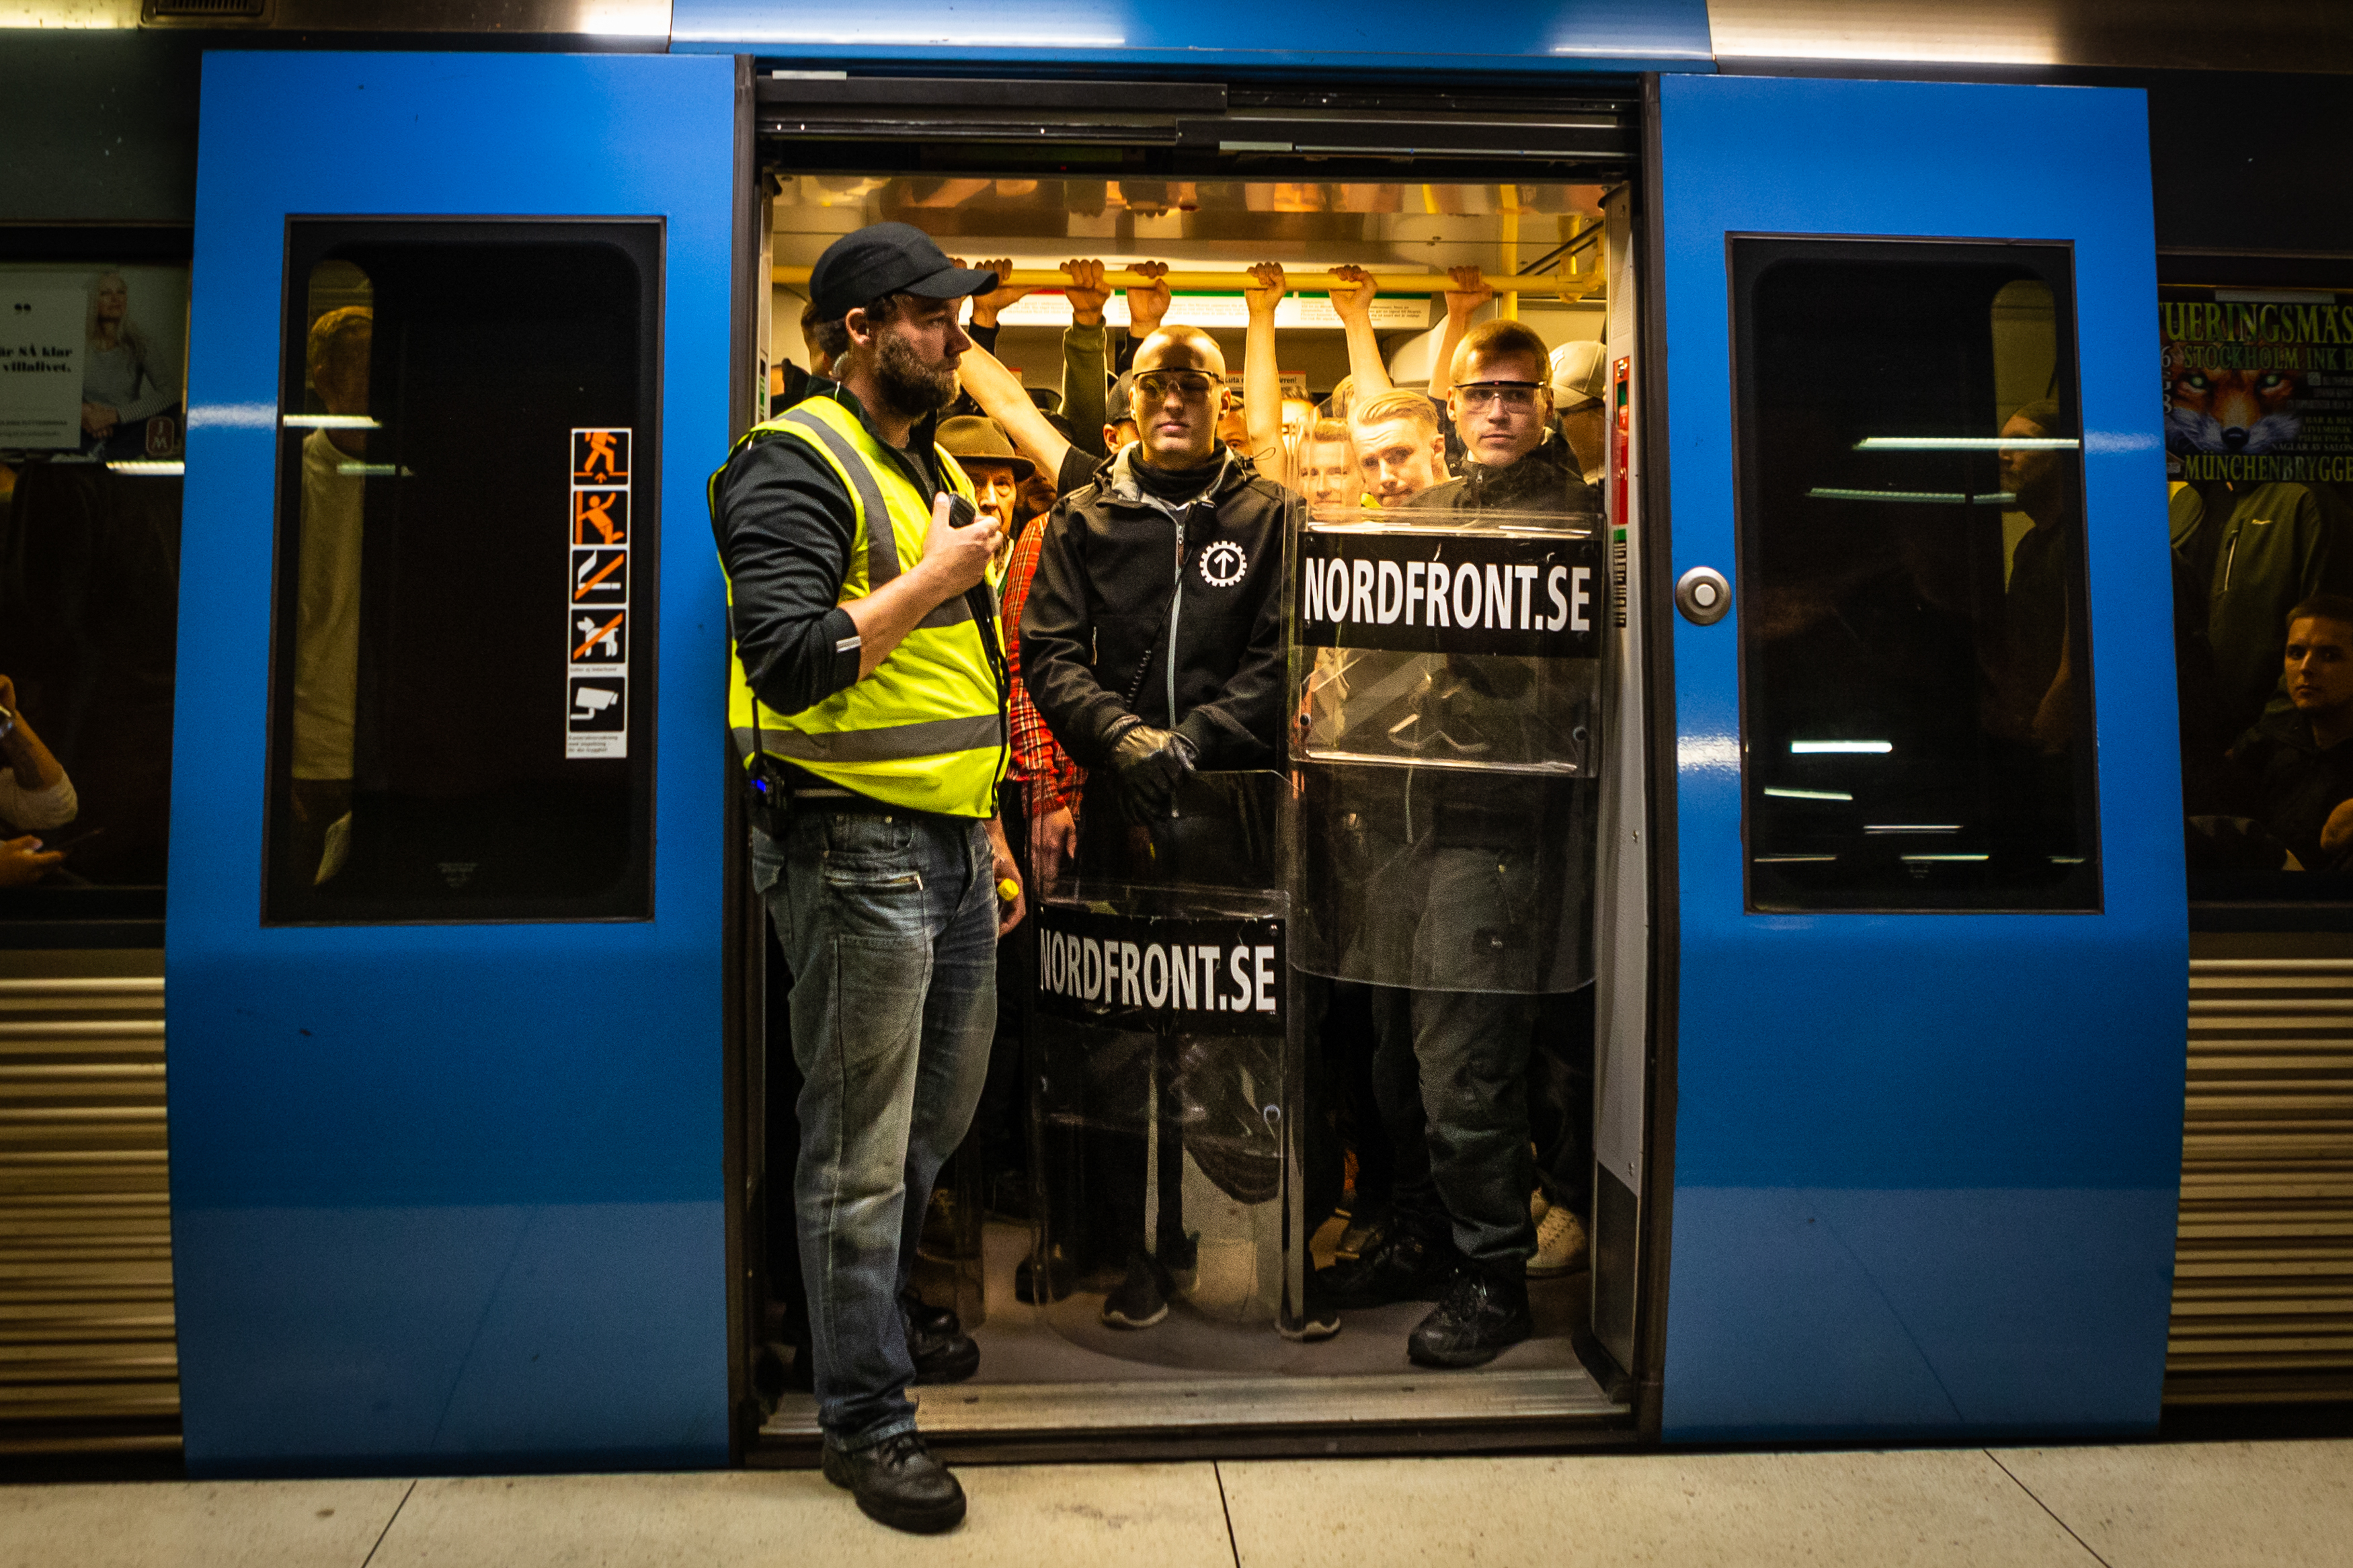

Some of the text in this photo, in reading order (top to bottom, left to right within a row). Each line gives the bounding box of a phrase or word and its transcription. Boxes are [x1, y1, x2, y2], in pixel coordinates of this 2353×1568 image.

[2159, 302, 2353, 343] UERINGSMÄS
[2184, 345, 2299, 370] STOCKHOLM
[2306, 347, 2340, 370] INK
[1304, 557, 1591, 632] NORDFRONT.SE
[1040, 927, 1277, 1012] NORDFRONT.SE
